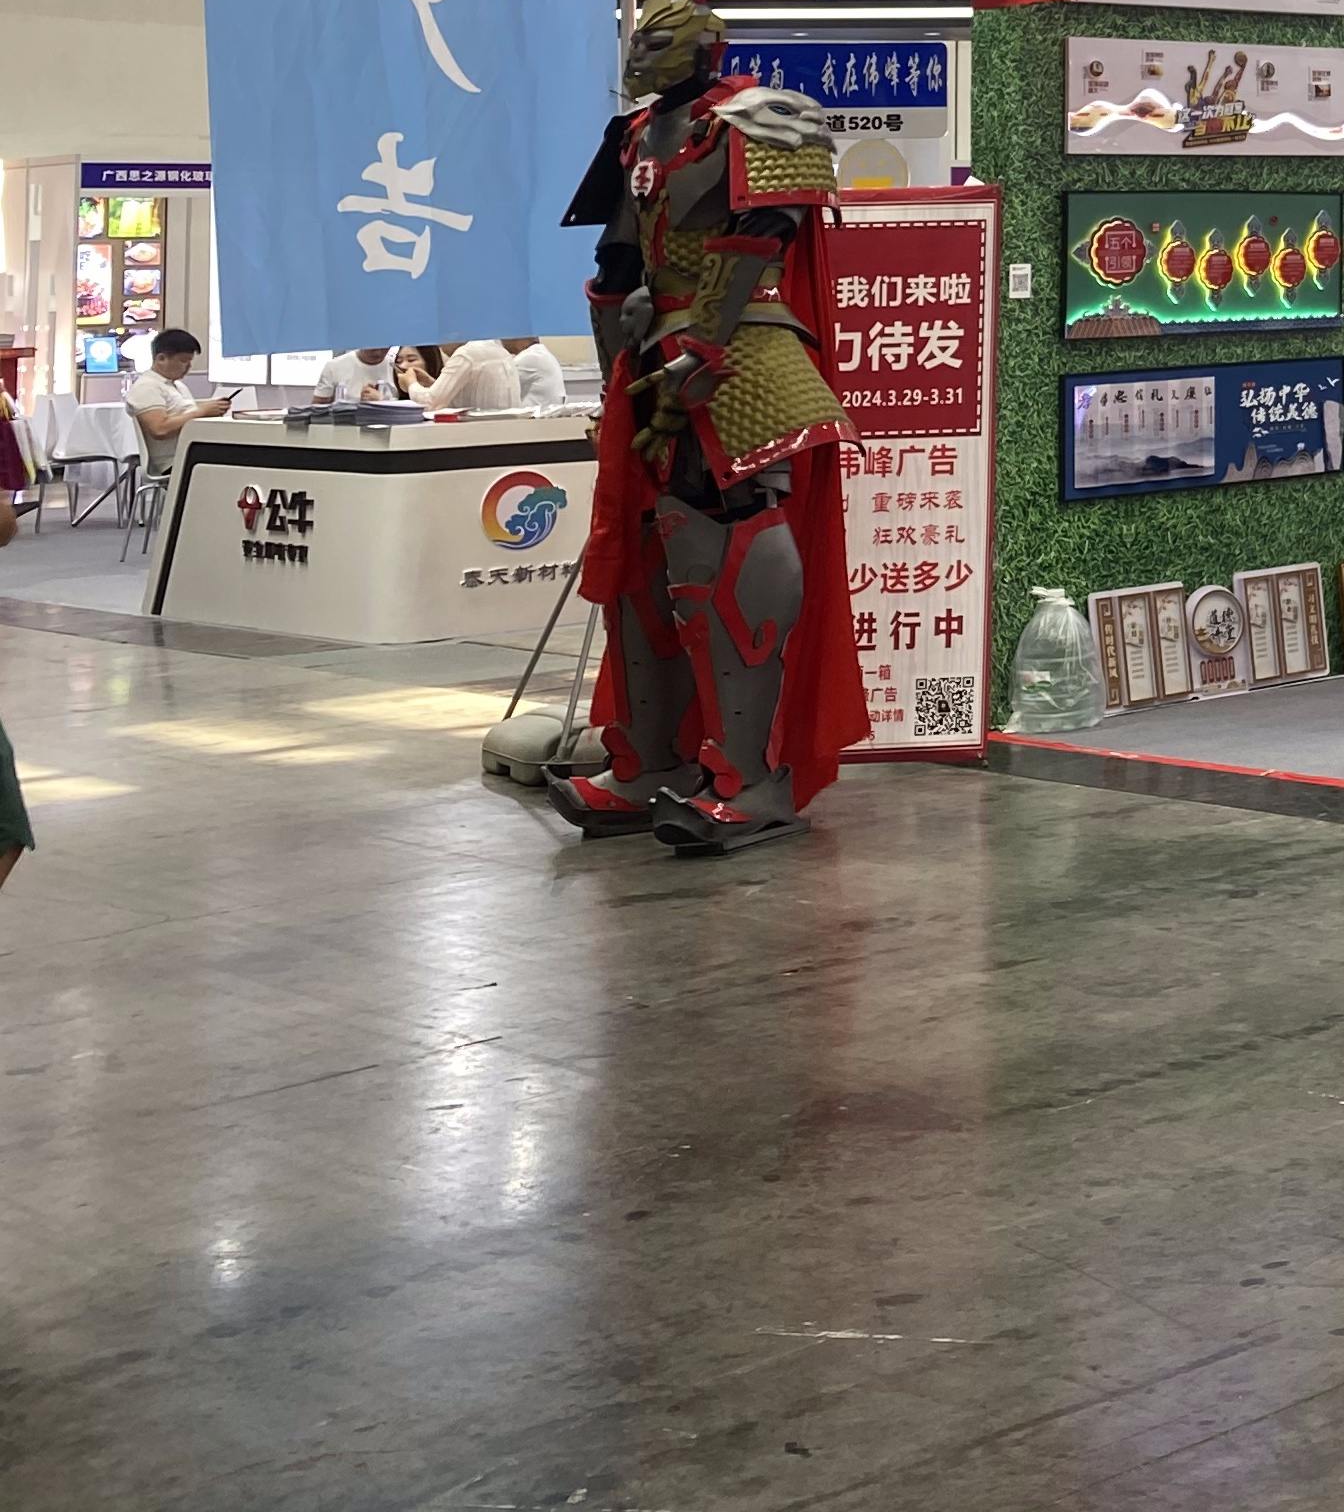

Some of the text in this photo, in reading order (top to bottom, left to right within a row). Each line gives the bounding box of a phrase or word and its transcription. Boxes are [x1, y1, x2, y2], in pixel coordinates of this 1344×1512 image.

[826, 113, 904, 133] 道520号
[836, 271, 972, 309] 我们来啦
[842, 388, 964, 408] 2024.3.29-3.31
[872, 490, 963, 513] 重磅来袭
[872, 524, 965, 546] 狂欢豪礼
[849, 559, 973, 596] 少送多少
